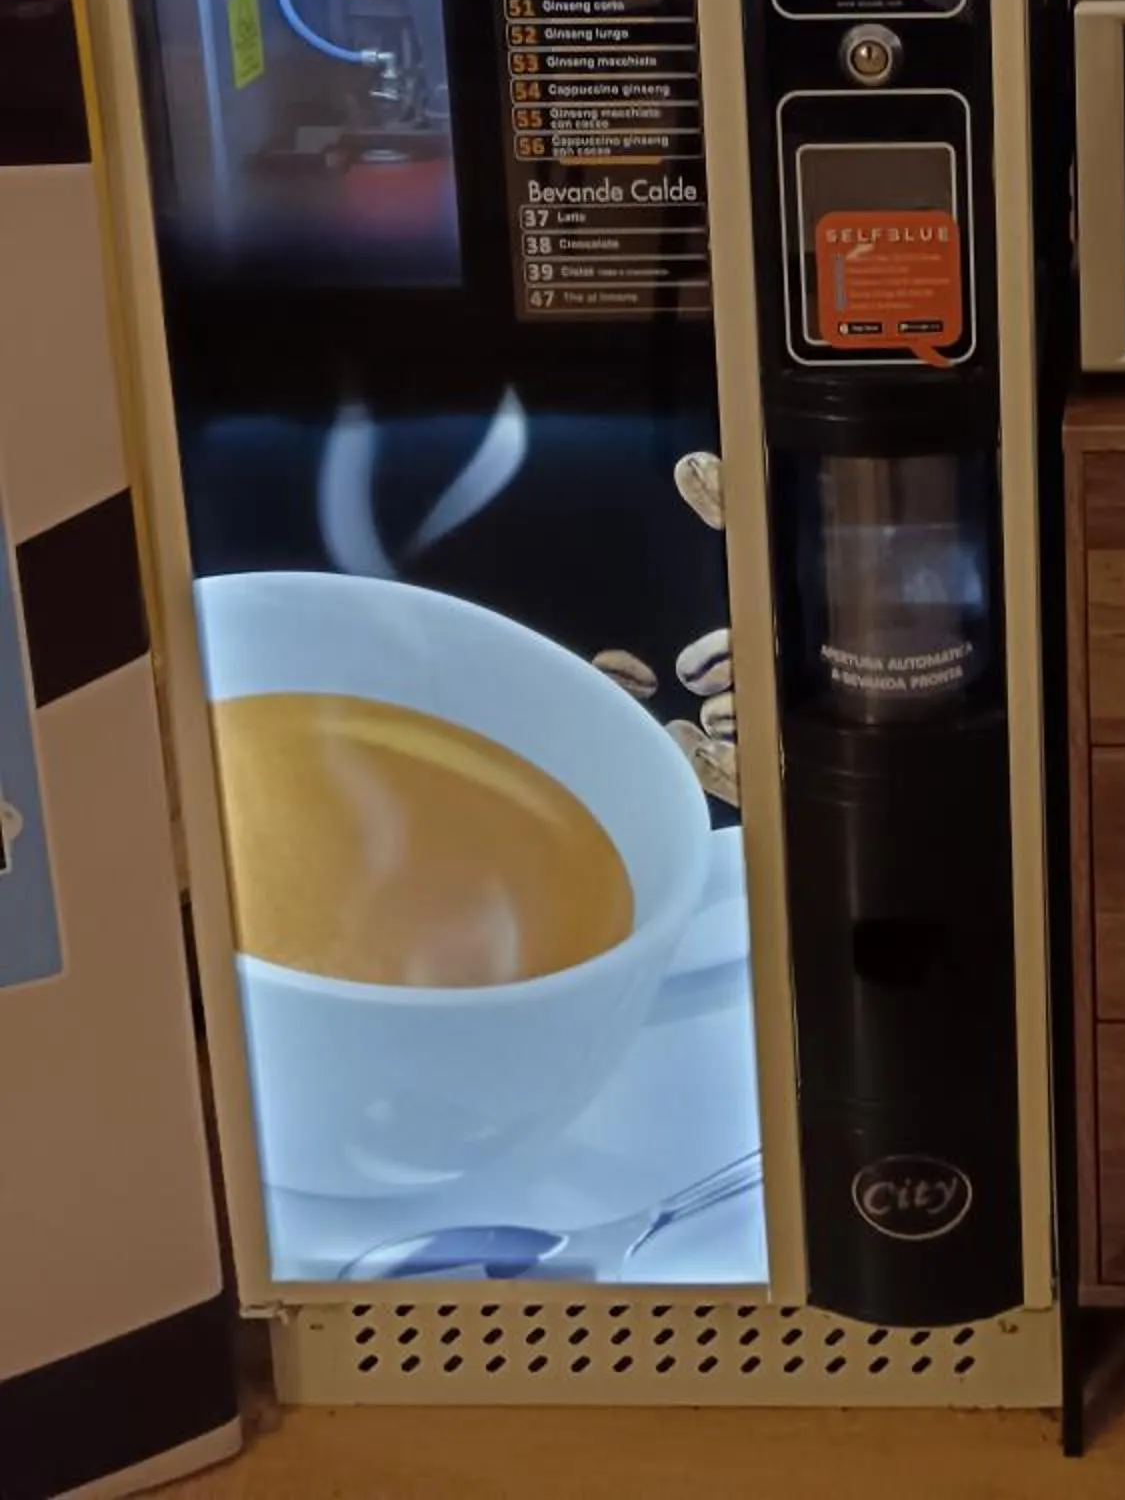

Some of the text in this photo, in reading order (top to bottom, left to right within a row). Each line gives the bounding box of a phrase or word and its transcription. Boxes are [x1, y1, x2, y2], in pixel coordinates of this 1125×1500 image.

[510, 26, 538, 44] 52
[512, 53, 540, 72] 53
[515, 81, 541, 100] 54
[516, 110, 543, 128] 55
[519, 137, 545, 156] 56
[526, 175, 698, 201] Bevande Calde
[524, 209, 549, 227] 37
[526, 236, 552, 255] 38
[527, 263, 553, 282] 39
[529, 290, 555, 308] 47
[862, 1174, 958, 1216] City
